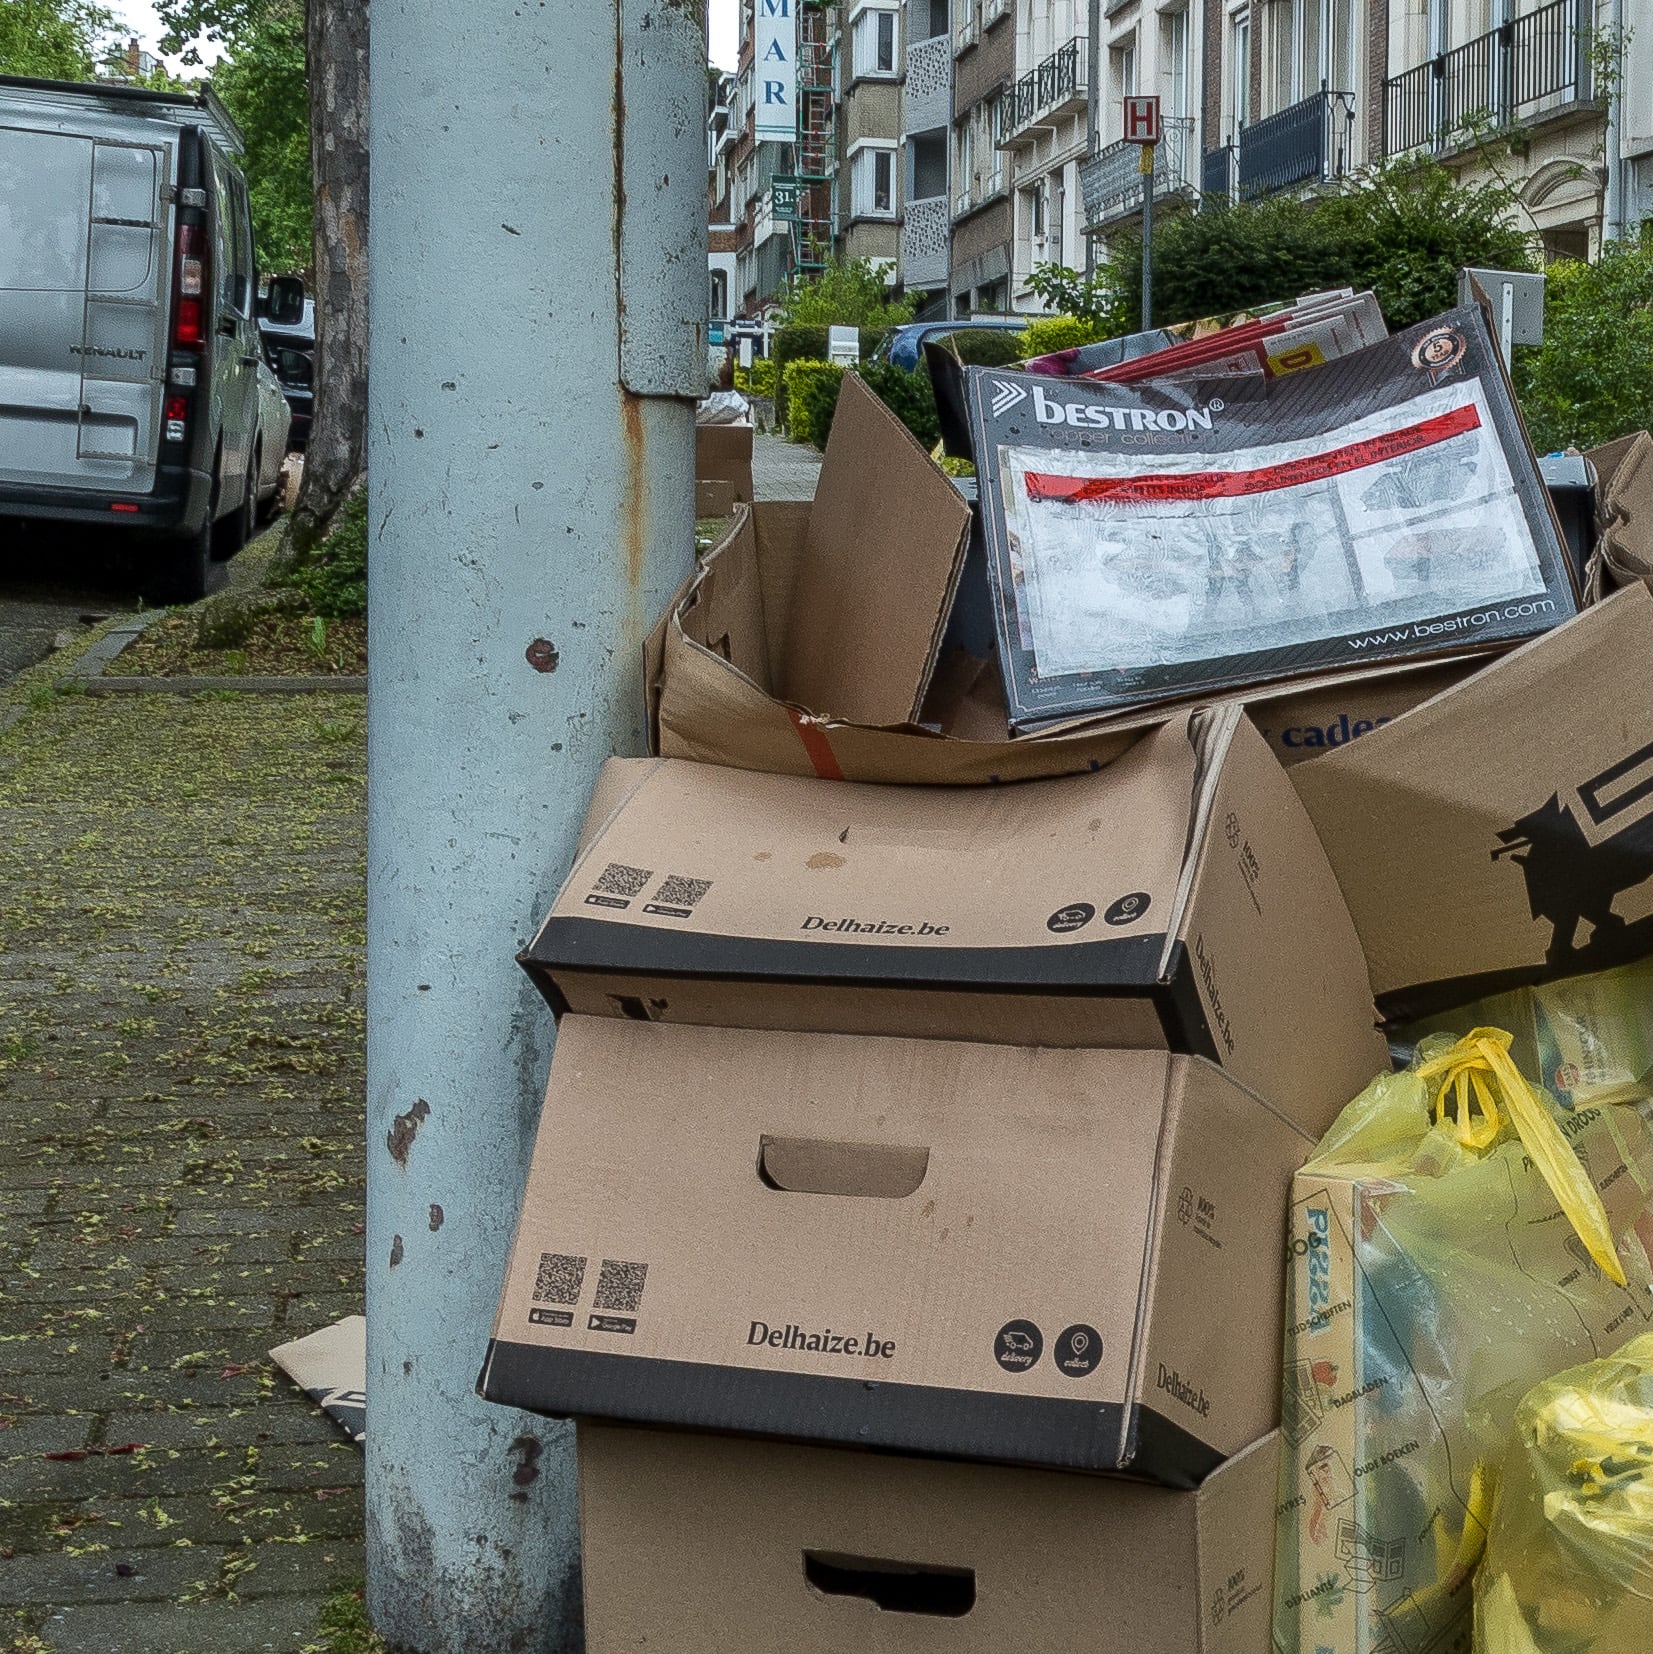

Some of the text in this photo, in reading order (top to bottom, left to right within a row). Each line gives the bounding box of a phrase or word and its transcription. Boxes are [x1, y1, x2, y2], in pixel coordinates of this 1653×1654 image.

[1130, 101, 1153, 136] H
[69, 345, 147, 361] RENAULT
[1348, 599, 1556, 649] www.bestron.com
[800, 915, 950, 938] Delhaize.be
[1195, 932, 1235, 1056] Delhaize.be
[746, 1320, 897, 1359] Delhaize.be
[1156, 1361, 1211, 1419] Delhaize.be
